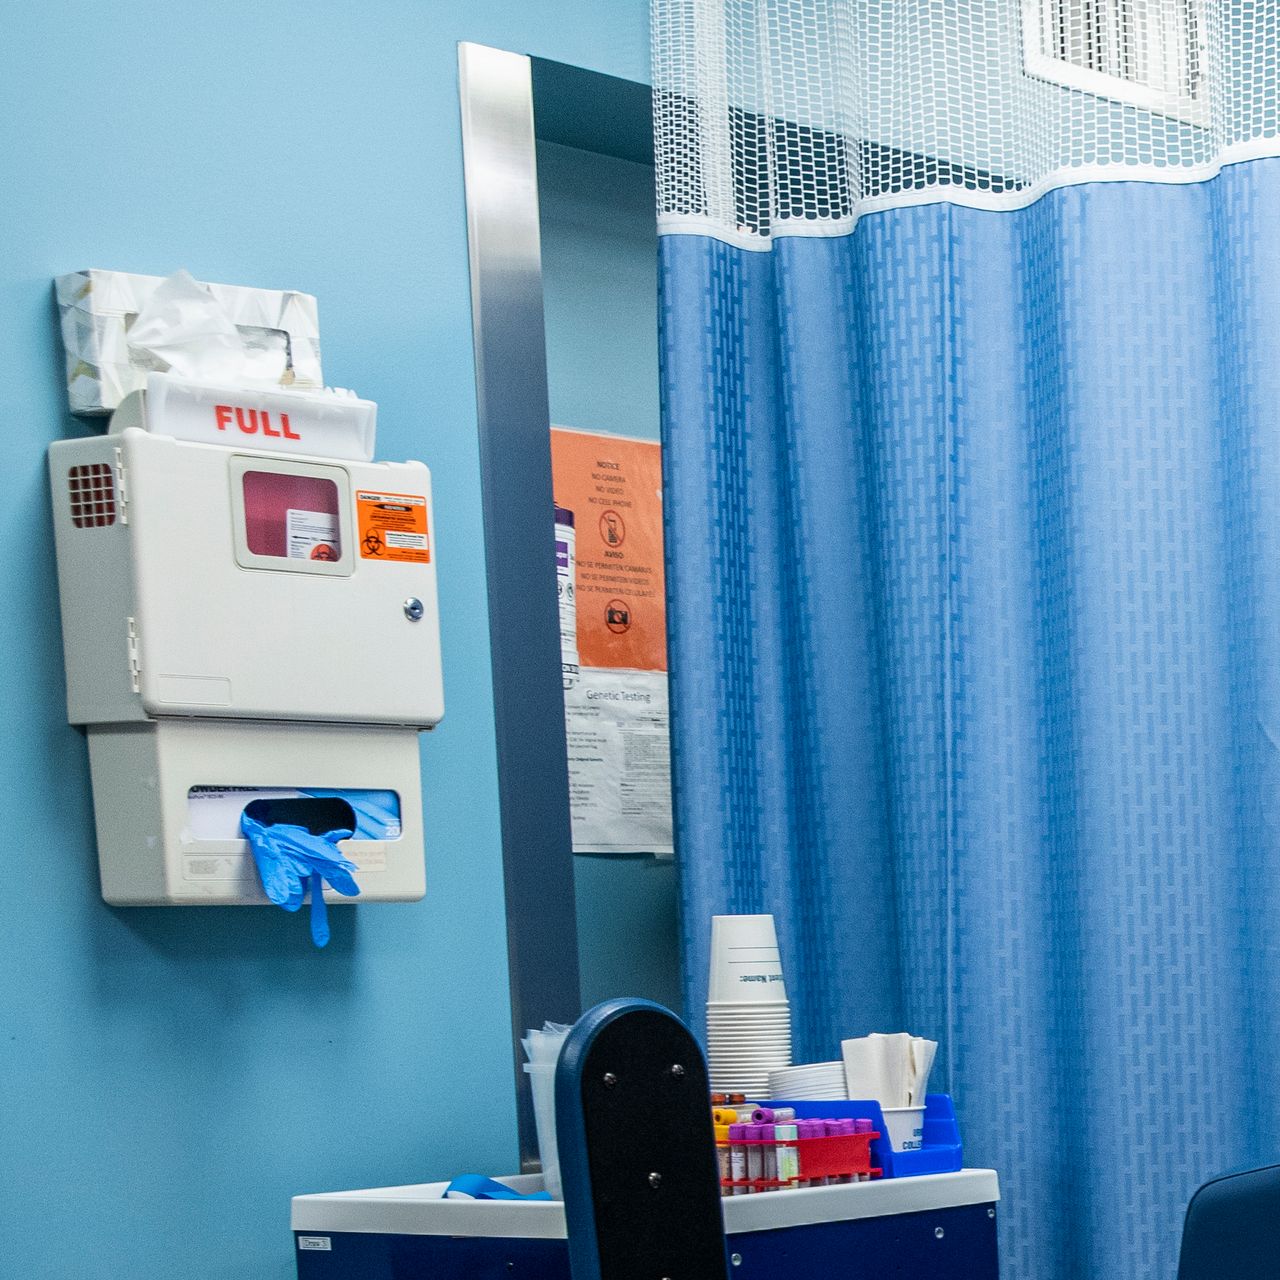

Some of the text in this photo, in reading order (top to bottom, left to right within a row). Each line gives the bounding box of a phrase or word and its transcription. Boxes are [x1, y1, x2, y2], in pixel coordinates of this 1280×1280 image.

[215, 405, 300, 440] FULL
[596, 461, 620, 470] NOTICE
[601, 475, 626, 483] CAMERA
[606, 487, 625, 495] VIDEO
[604, 550, 625, 560] AVISO
[586, 689, 652, 704] Genetic Testing
